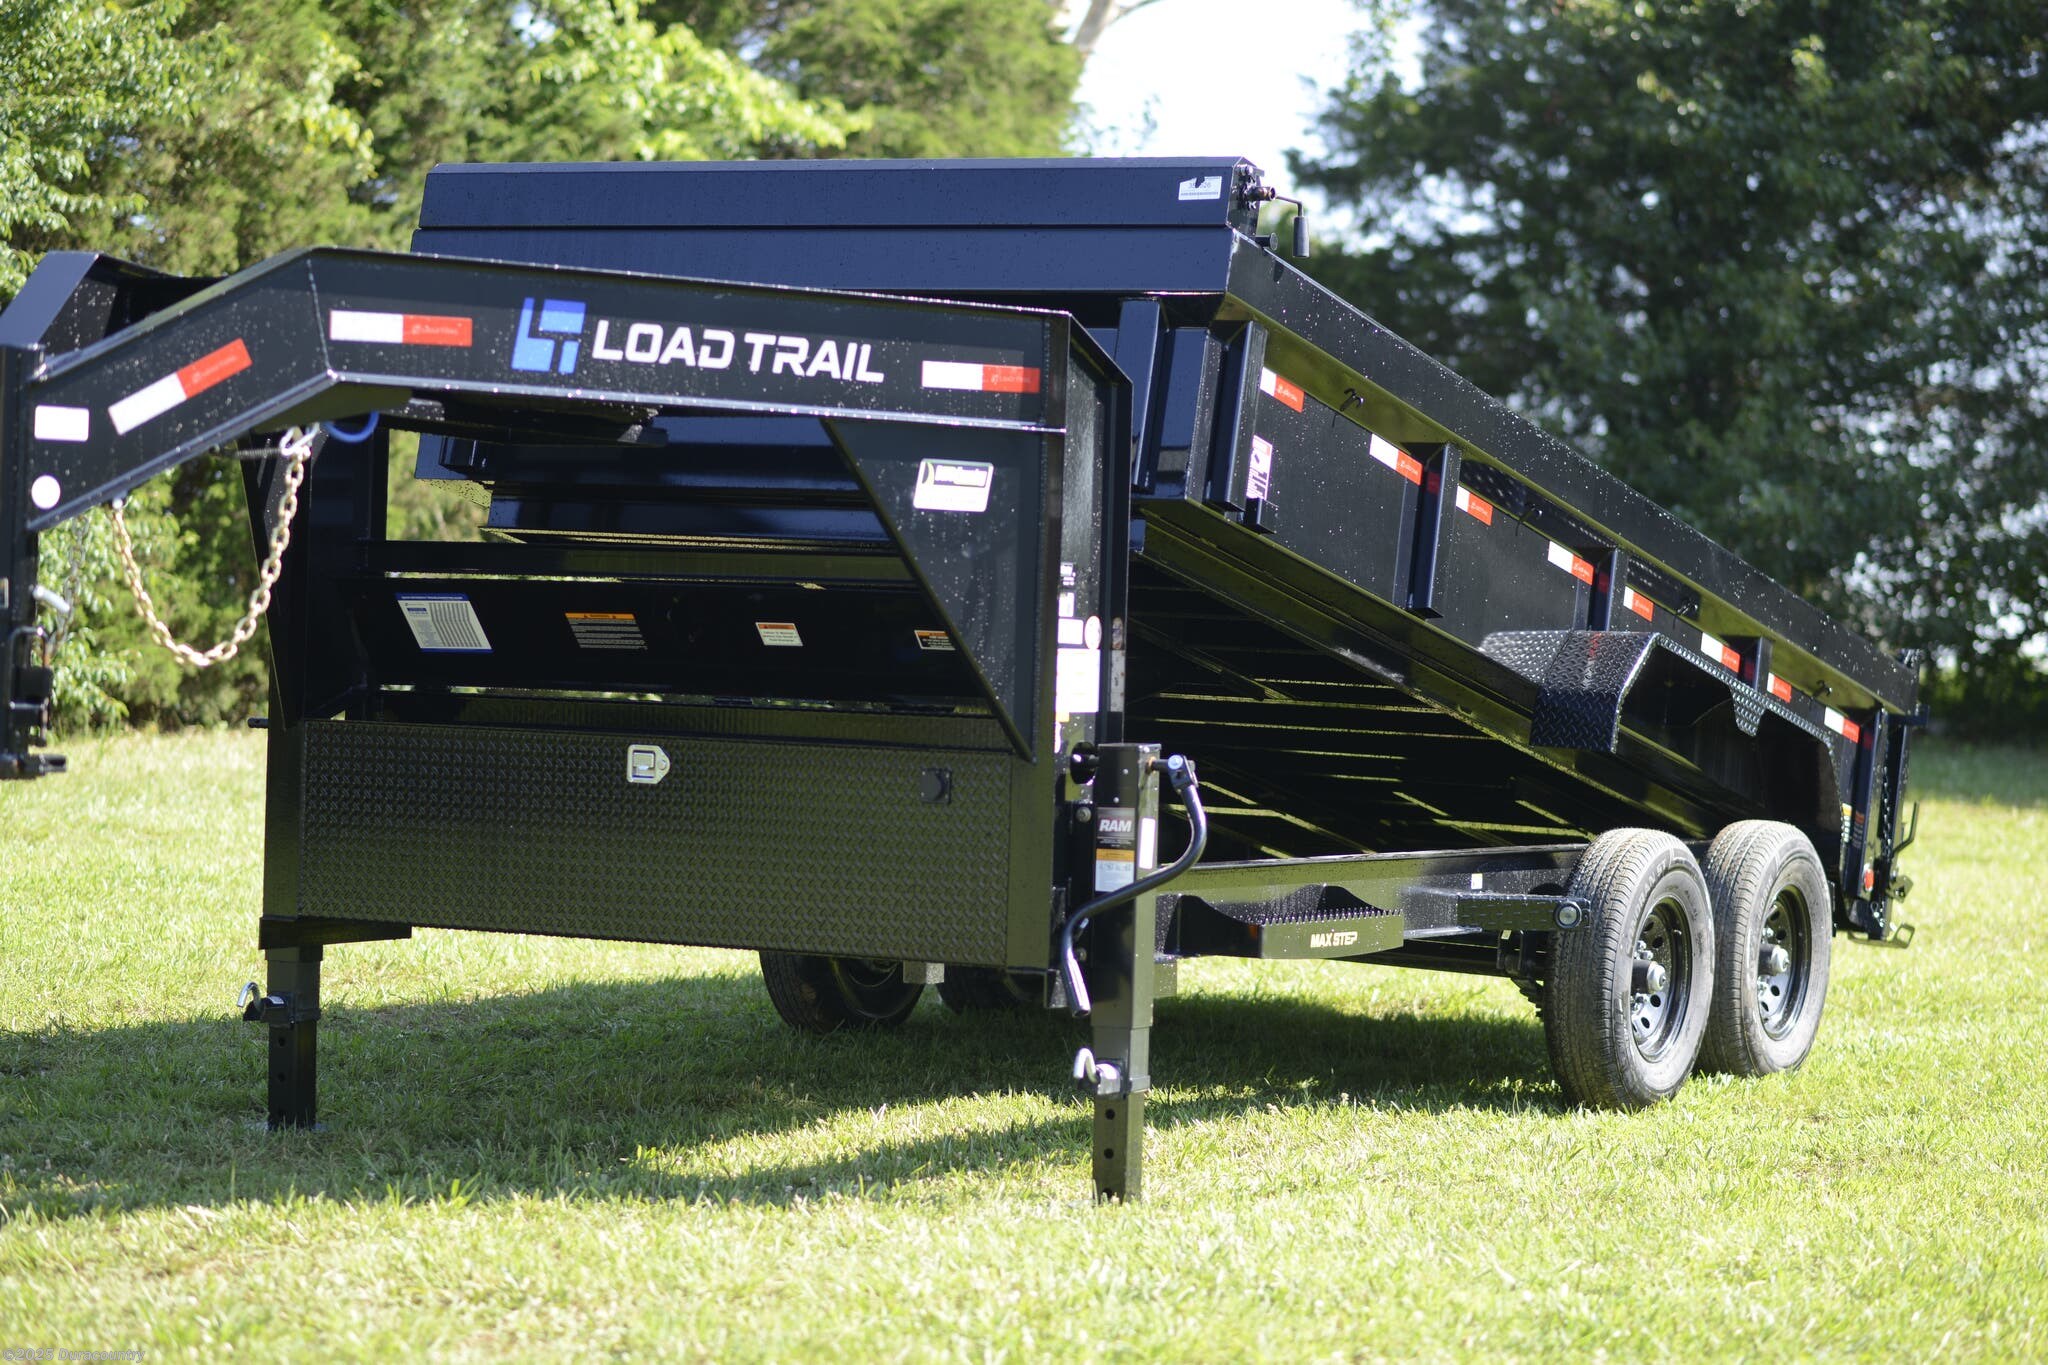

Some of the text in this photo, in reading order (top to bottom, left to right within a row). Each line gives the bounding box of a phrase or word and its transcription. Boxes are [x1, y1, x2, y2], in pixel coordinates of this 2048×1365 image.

[592, 319, 885, 383] LOAD TRAIL
[1099, 819, 1132, 832] RAM
[1310, 931, 1358, 947] MAX STEP
